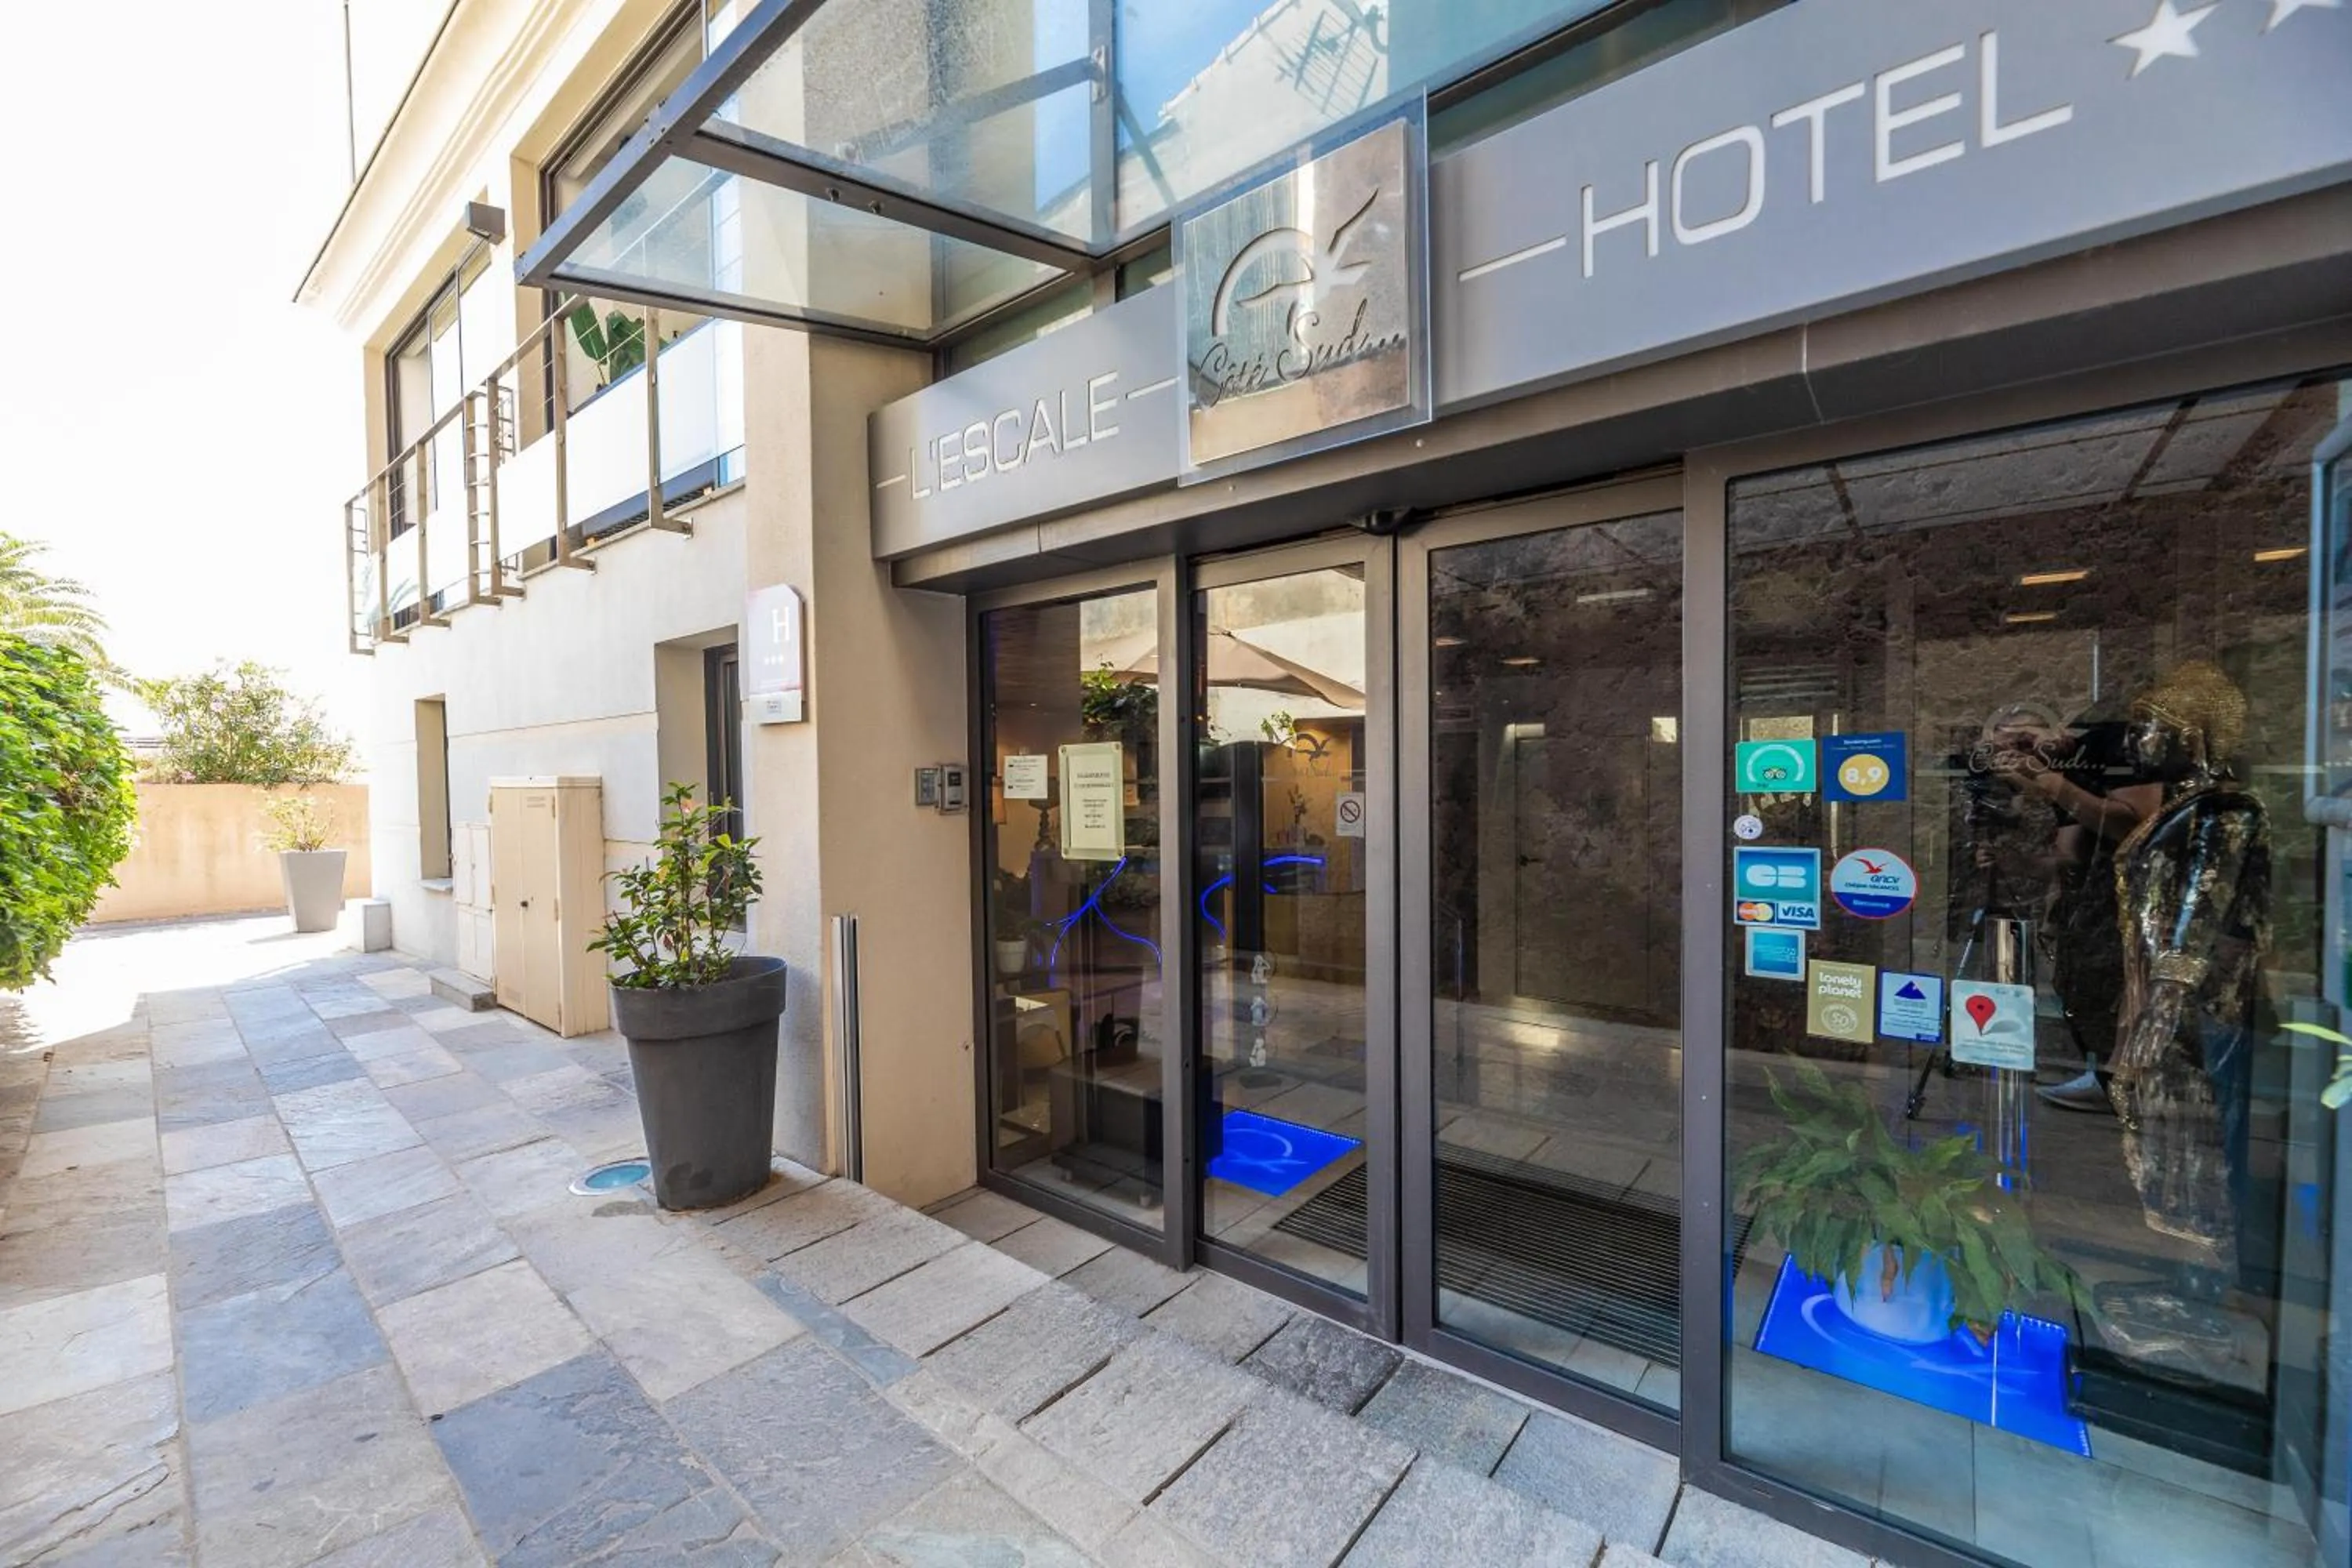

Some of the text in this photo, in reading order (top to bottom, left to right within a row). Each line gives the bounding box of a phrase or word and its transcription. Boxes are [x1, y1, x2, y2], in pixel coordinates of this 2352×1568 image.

[1581, 30, 2074, 278] HOTEL
[910, 370, 1120, 500] L'ESCALE
[771, 606, 790, 644] H
[1845, 766, 1883, 786] 8,9
[1782, 906, 1815, 918] VISA
[1819, 972, 1862, 989] lonely
[1818, 985, 1863, 999] planet
